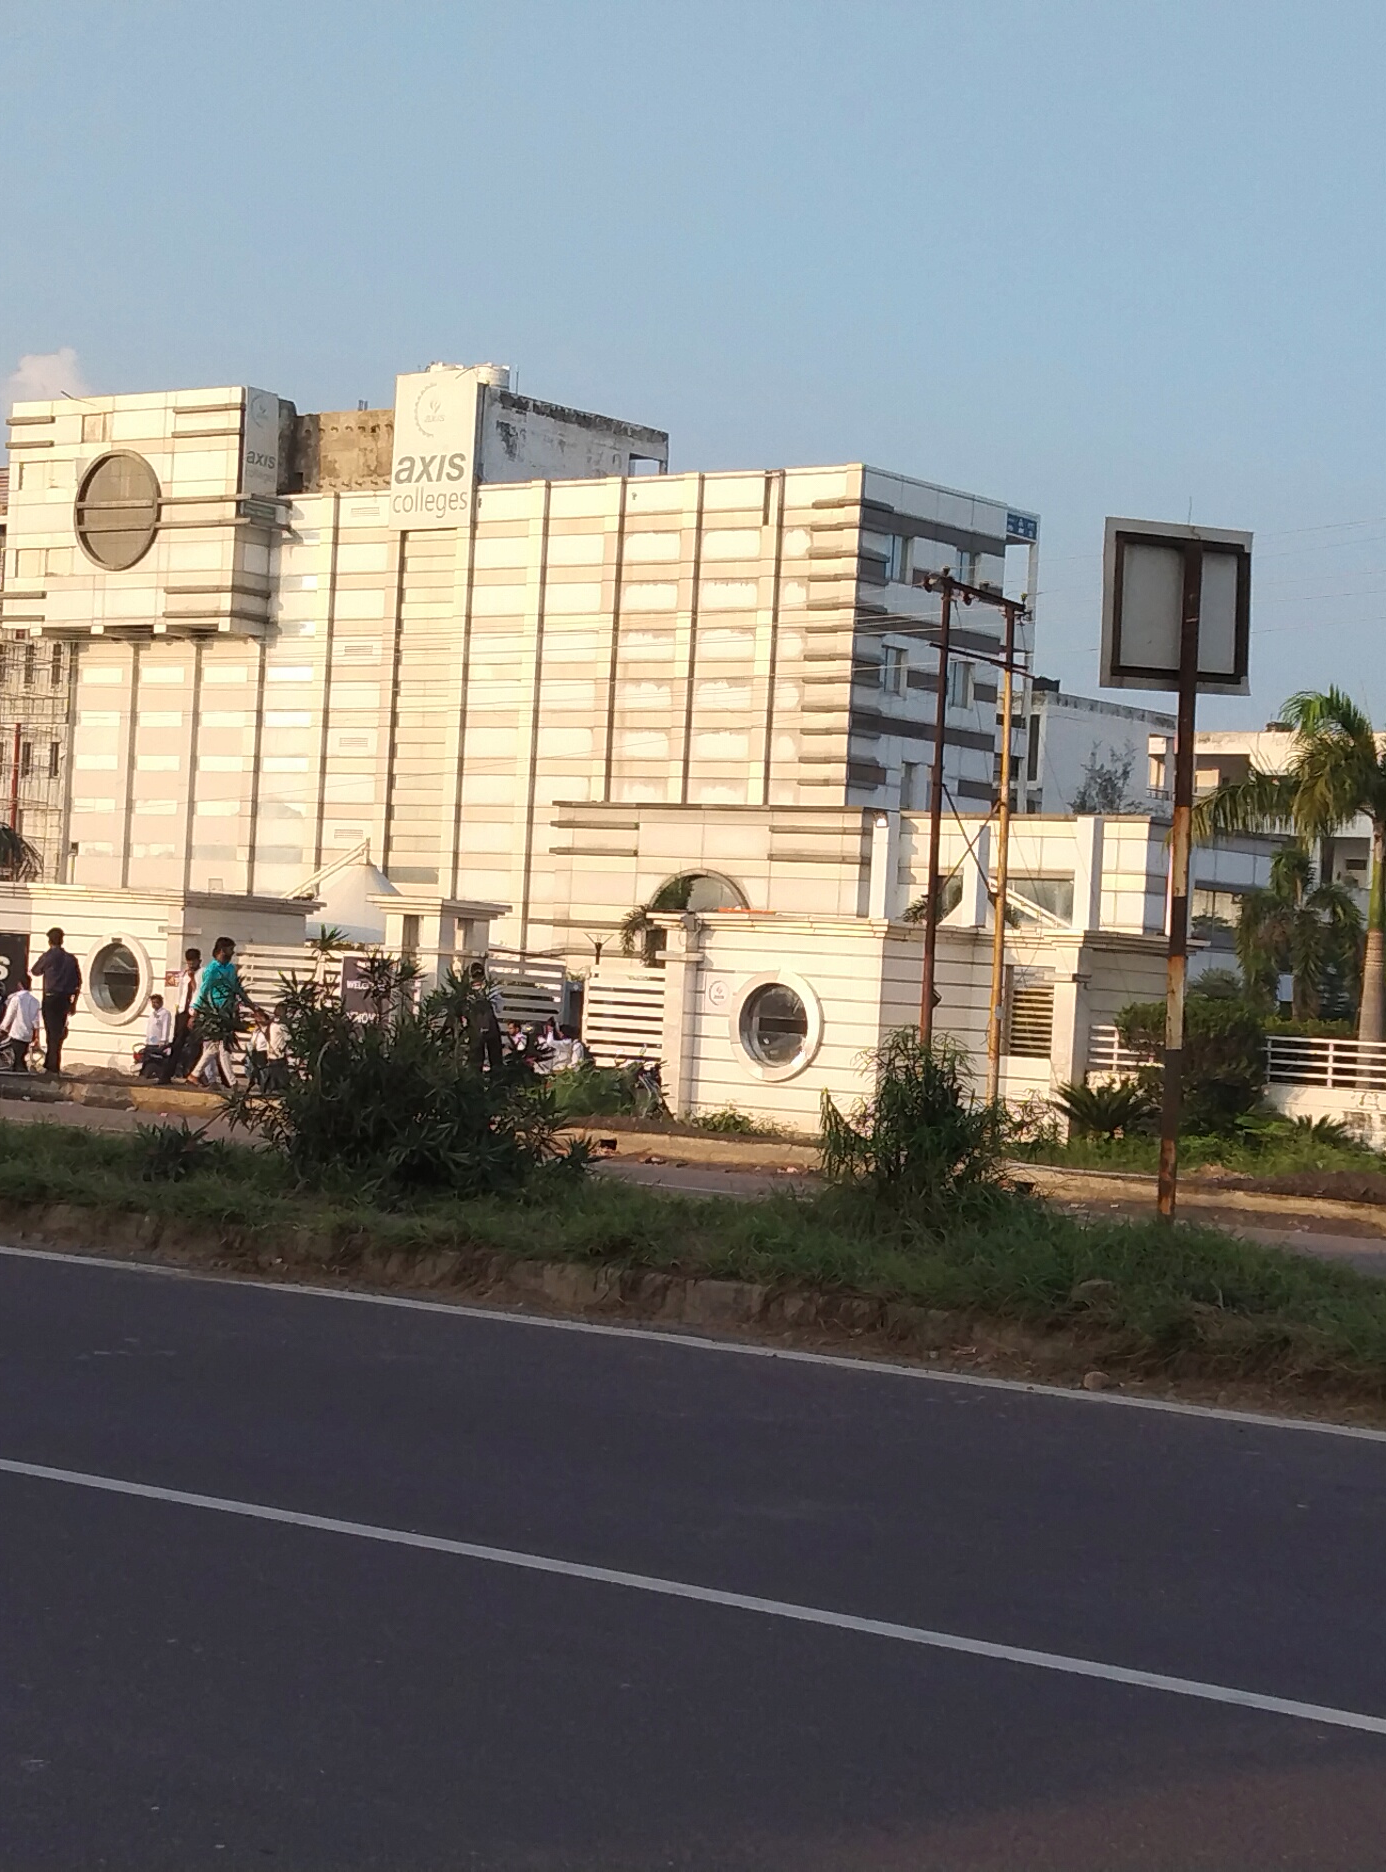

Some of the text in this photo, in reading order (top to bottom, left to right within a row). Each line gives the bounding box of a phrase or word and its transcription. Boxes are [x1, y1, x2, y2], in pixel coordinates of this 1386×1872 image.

[246, 450, 276, 469] axis
[394, 453, 466, 484] axis
[393, 486, 467, 518] colleges
